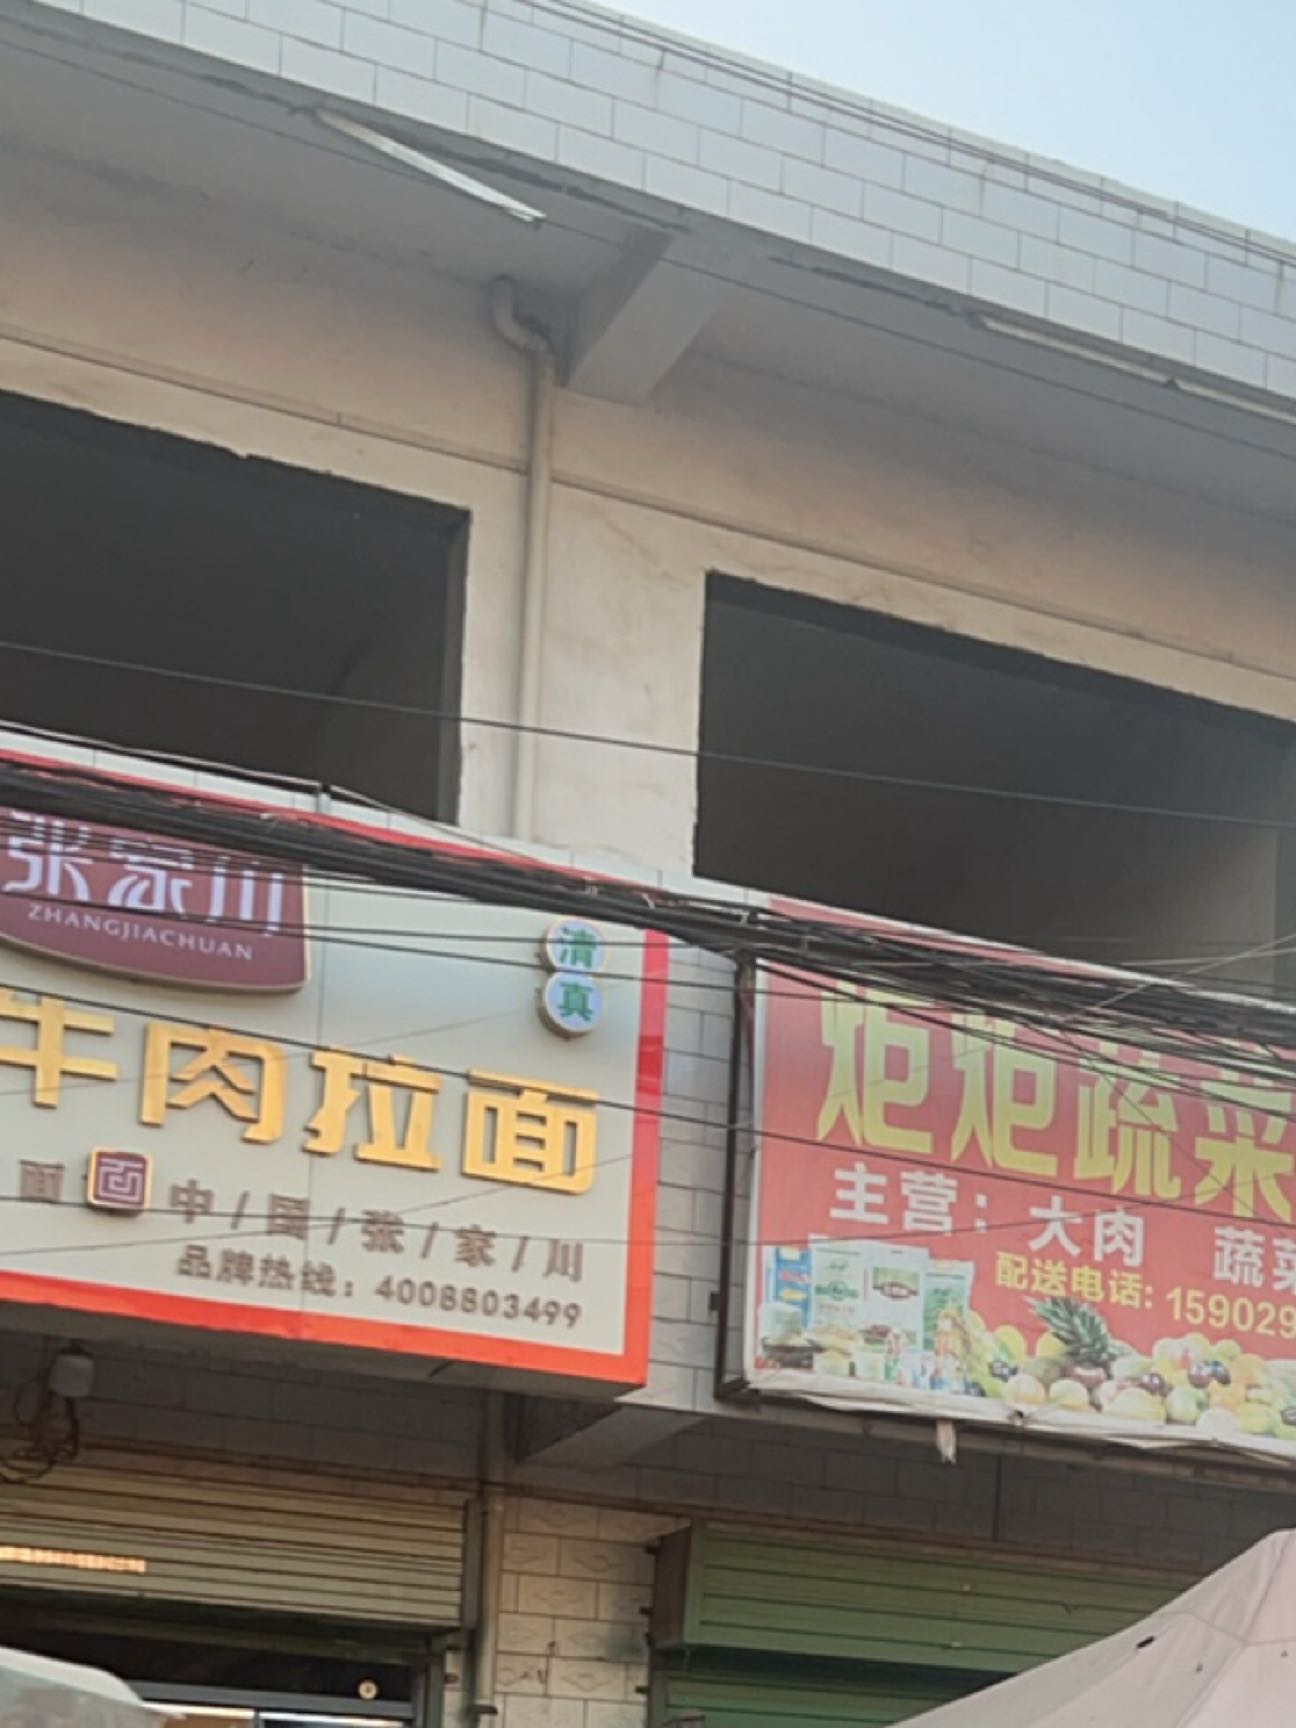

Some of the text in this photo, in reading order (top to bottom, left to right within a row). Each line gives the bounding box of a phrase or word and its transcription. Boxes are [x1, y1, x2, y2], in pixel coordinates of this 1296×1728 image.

[28, 904, 252, 960] ZHANGJIACHUAN
[558, 927, 596, 1021] 清真
[0, 988, 598, 1195] 牛肉拉面
[1028, 1195, 1144, 1266] 大肉
